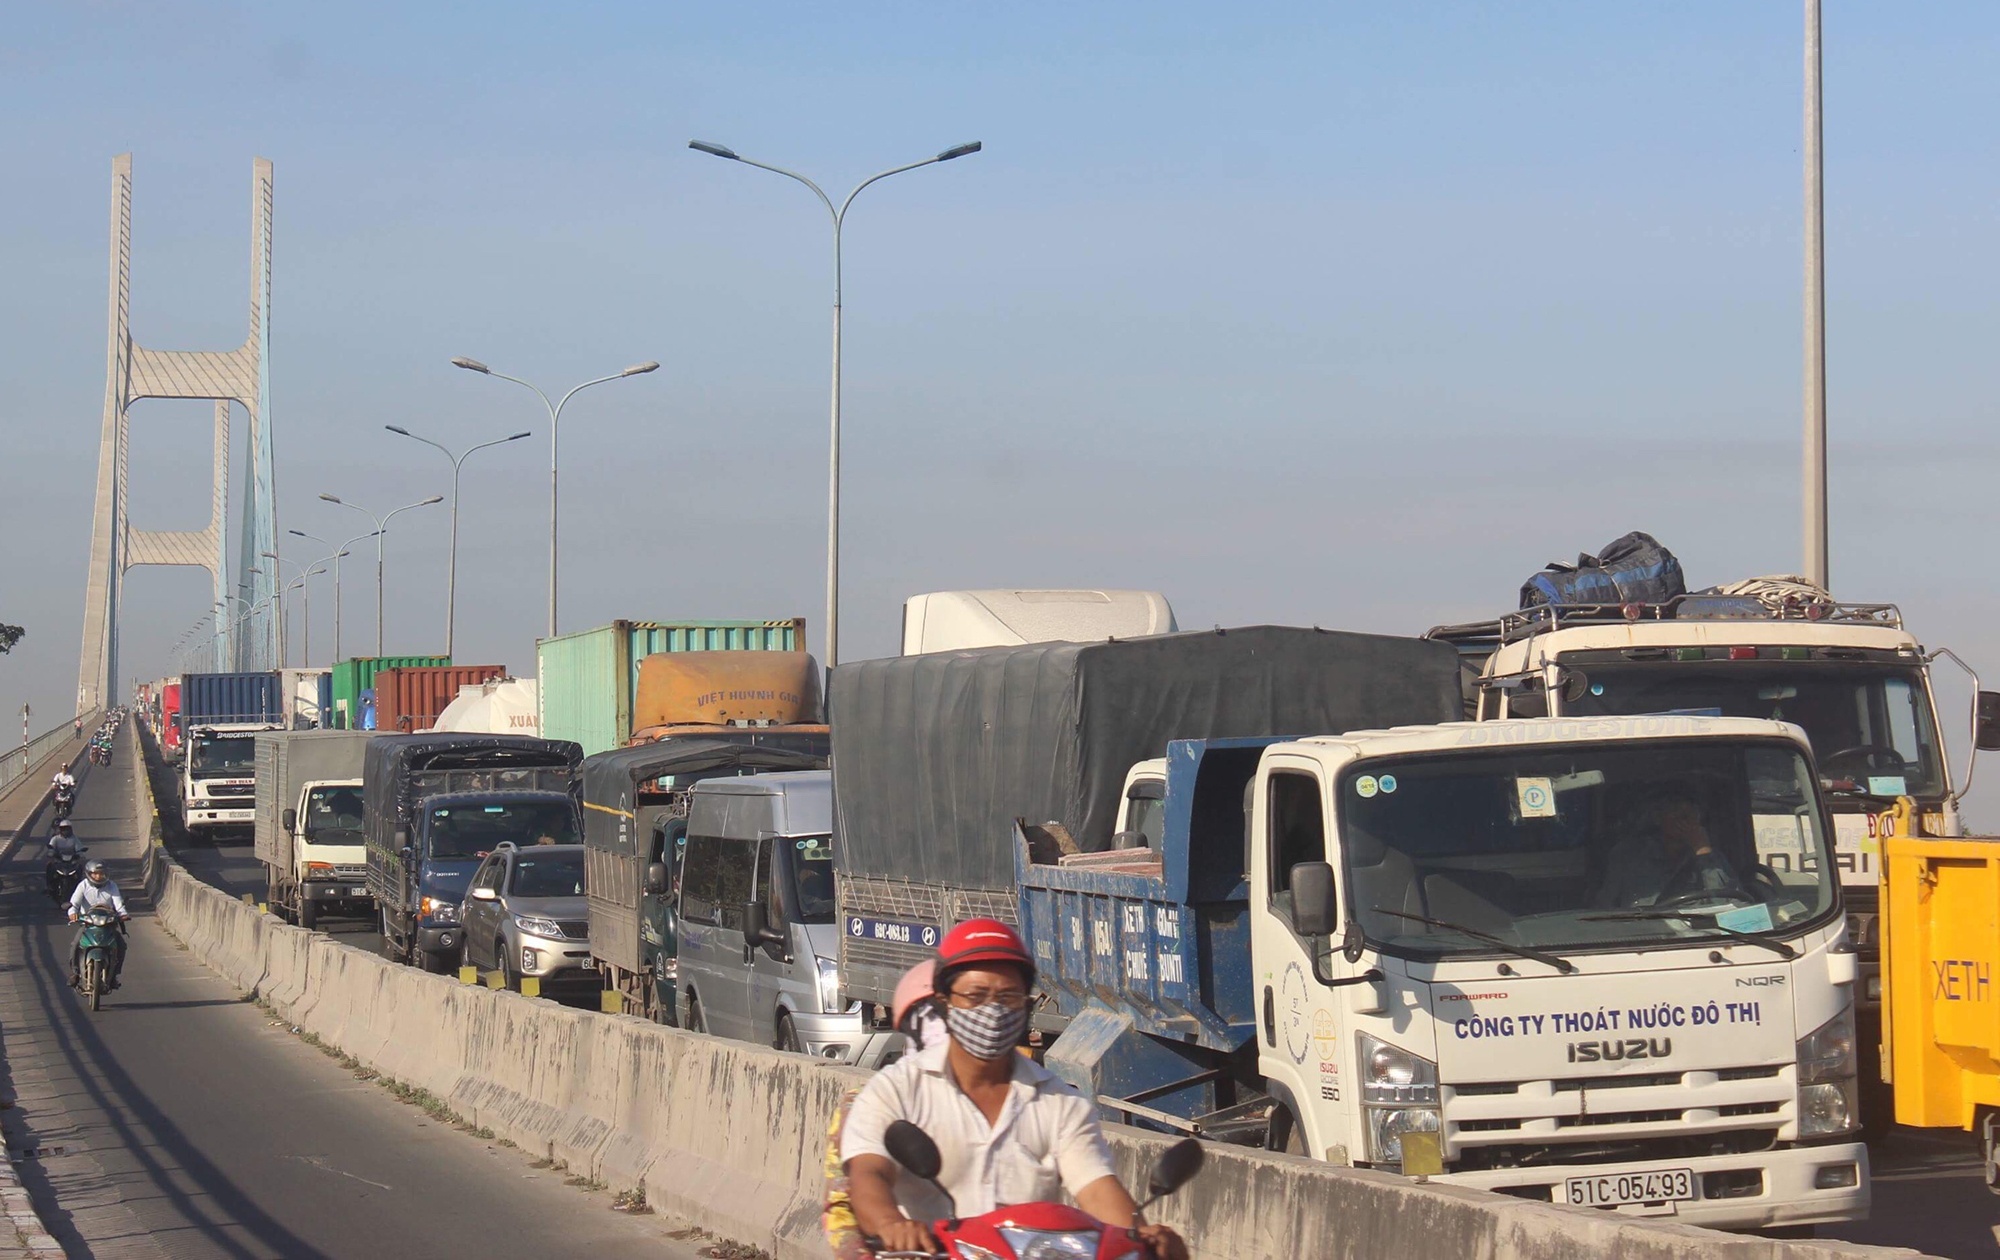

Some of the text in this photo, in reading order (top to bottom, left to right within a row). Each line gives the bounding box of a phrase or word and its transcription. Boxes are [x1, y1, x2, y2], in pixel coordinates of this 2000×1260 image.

[1735, 975, 1786, 987] NQR
[1439, 992, 1509, 1001] FORWARD
[1454, 1000, 1761, 1040] CÔNG TY THOÁT NƯỚC ĐÔ THỊ
[1567, 1037, 1672, 1063] ISUZU
[1320, 1062, 1339, 1075] ISUZU
[1571, 1172, 1688, 1204] 51C-054.93
